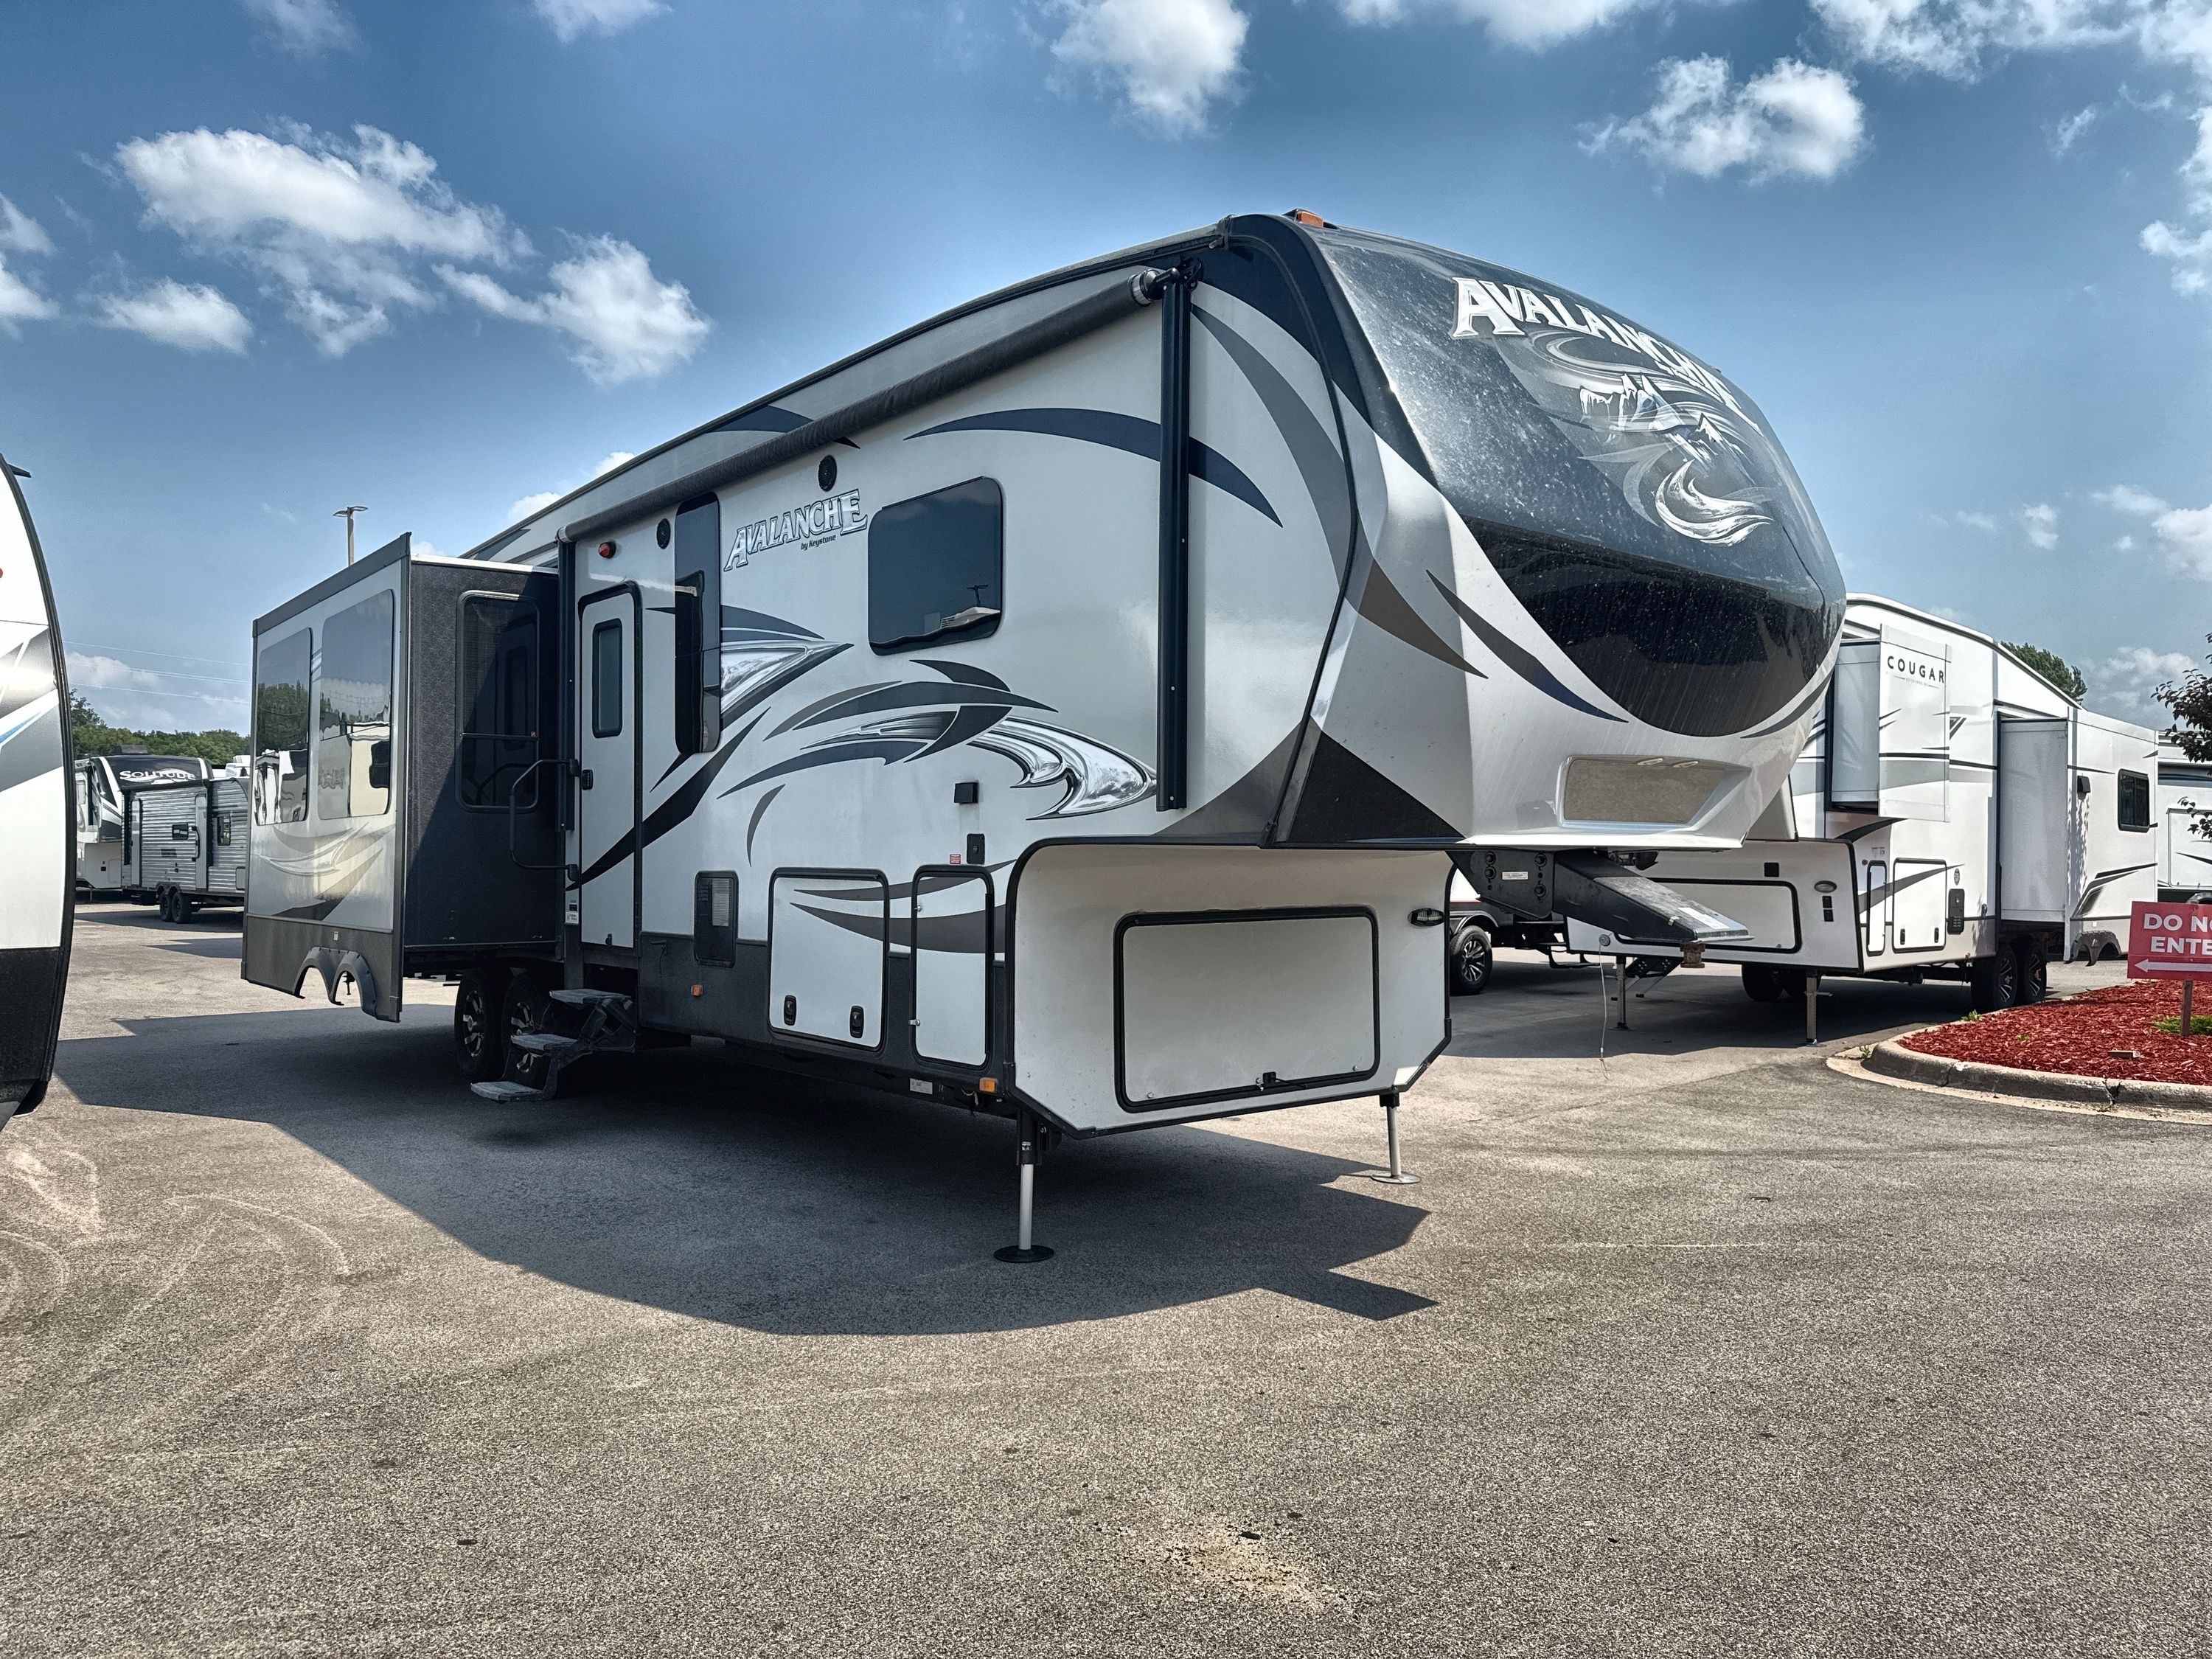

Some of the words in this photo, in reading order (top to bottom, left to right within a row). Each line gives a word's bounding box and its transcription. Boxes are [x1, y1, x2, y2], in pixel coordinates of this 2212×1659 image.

[1451, 276, 1764, 437] AVALANCHE
[723, 488, 868, 571] AVALANCHE
[801, 542, 808, 551] by
[809, 535, 836, 548] Keystone
[1887, 655, 1944, 684] COUGAR
[119, 771, 196, 781] SOLITUDE
[2143, 913, 2183, 931] DO
[2191, 916, 2212, 933] N
